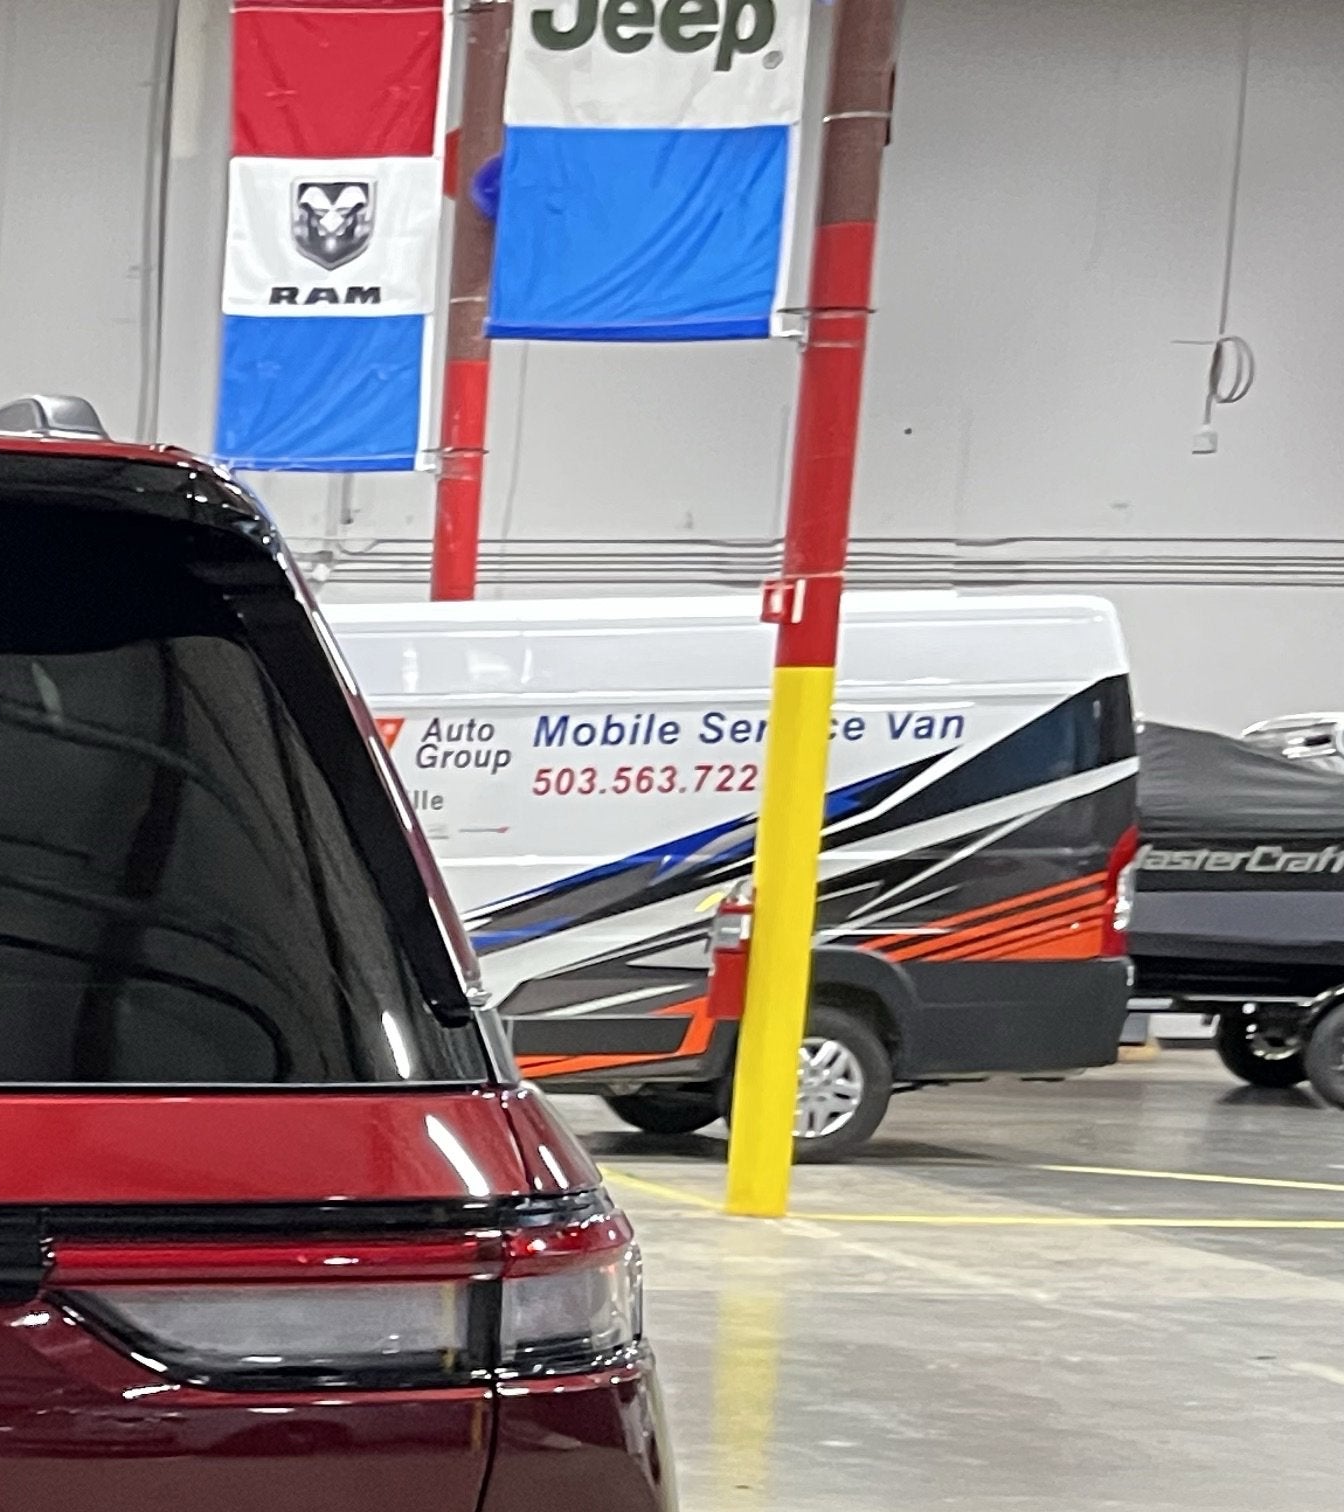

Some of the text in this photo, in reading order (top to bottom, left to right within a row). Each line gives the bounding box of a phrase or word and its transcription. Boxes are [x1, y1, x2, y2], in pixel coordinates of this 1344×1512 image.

[531, 0, 776, 71] Jeep
[268, 286, 381, 305] RAM
[421, 717, 495, 742] Auto
[532, 714, 680, 748] Mobile
[888, 712, 966, 741] Van
[415, 743, 512, 775] Group
[531, 764, 759, 796] 503.563.722
